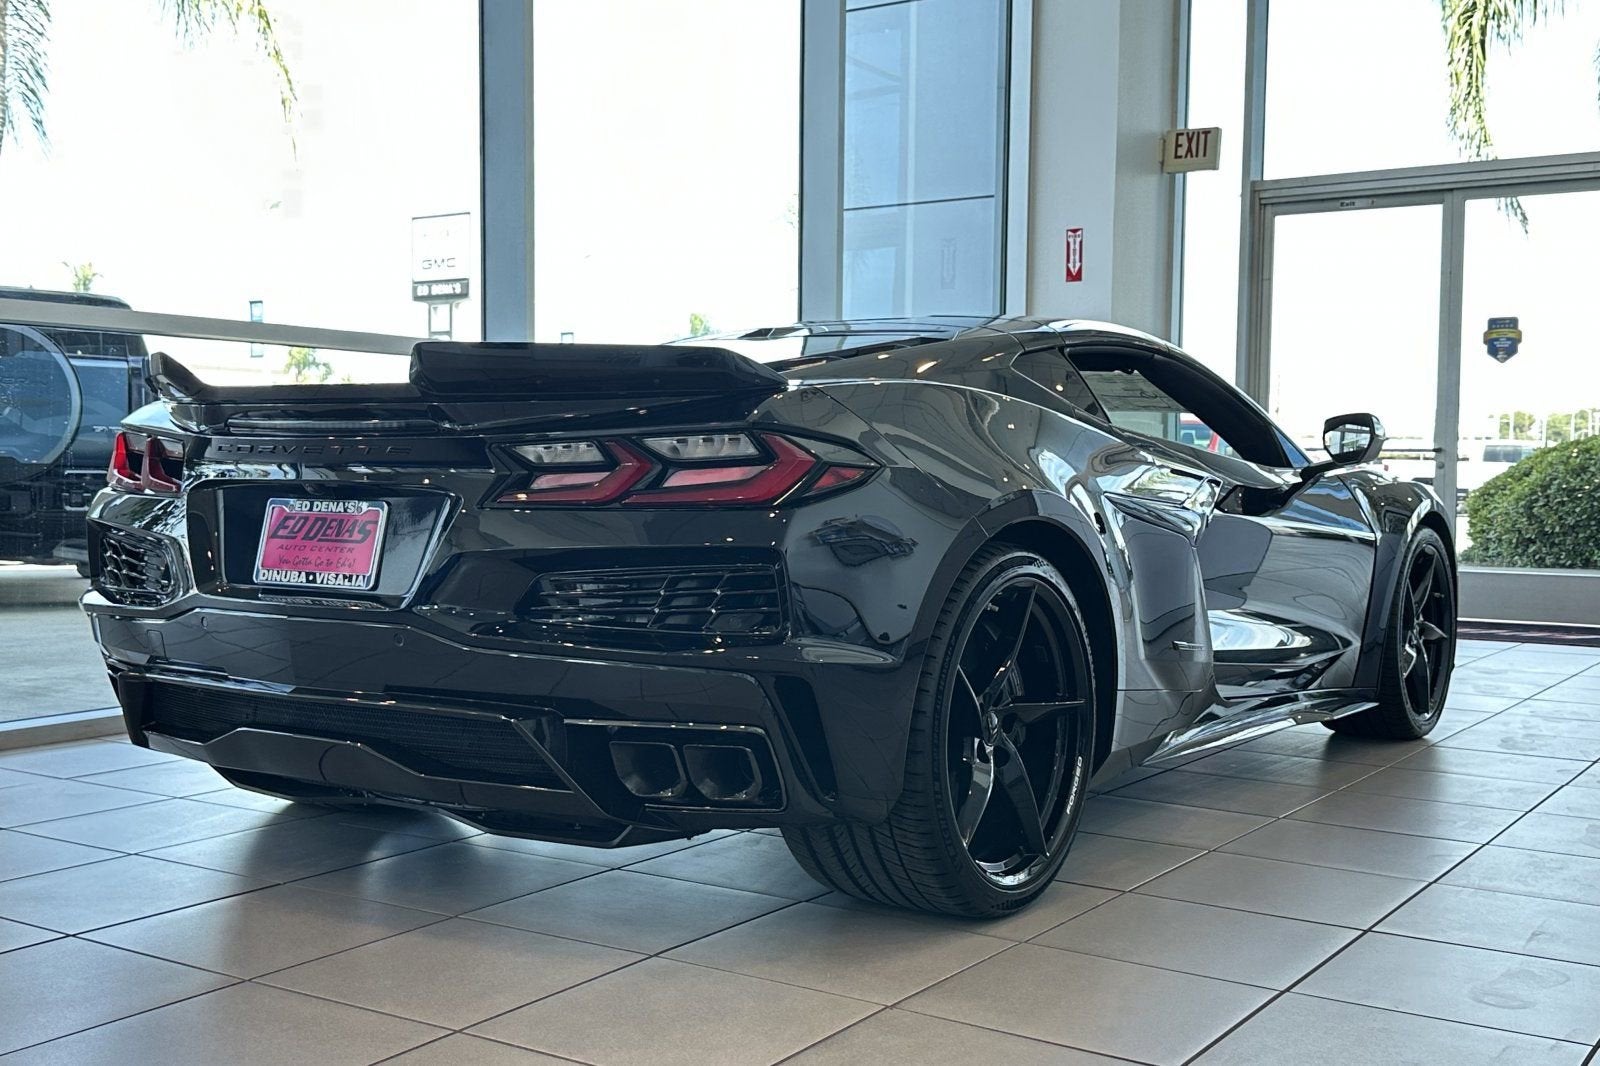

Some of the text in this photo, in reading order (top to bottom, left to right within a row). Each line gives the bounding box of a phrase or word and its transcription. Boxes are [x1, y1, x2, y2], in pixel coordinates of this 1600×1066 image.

[1174, 130, 1211, 160] EXIT
[422, 257, 456, 270] GMC
[218, 443, 412, 455] CORVETTE
[294, 500, 355, 513] ED DENA'S
[270, 514, 379, 544] ED DENA'S
[277, 544, 355, 554] AUTO CENTER
[278, 553, 291, 566] You
[292, 555, 313, 567] Gotta
[314, 556, 325, 567] Go
[326, 558, 333, 567] to
[259, 569, 307, 583] DINUBA
[1066, 756, 1083, 815] FORGED
